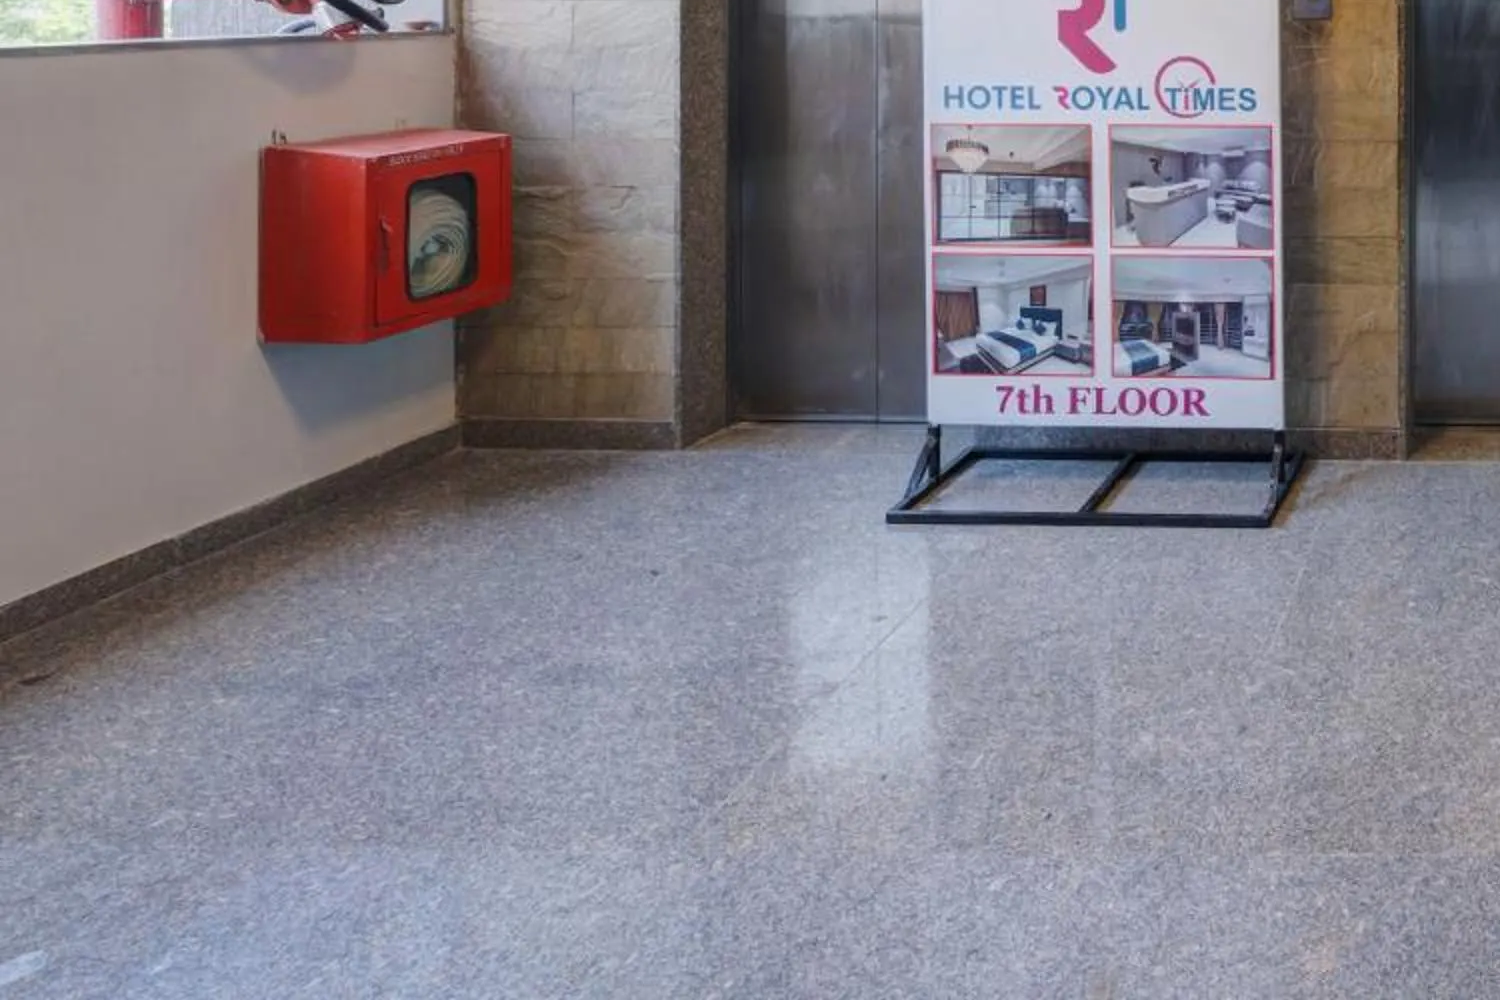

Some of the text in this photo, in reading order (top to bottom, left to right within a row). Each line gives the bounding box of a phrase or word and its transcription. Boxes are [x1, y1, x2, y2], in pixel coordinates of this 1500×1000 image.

[943, 85, 1041, 111] HOTEL
[1052, 85, 1150, 111] ROYAL
[996, 384, 1211, 417] 7th FLOOR
